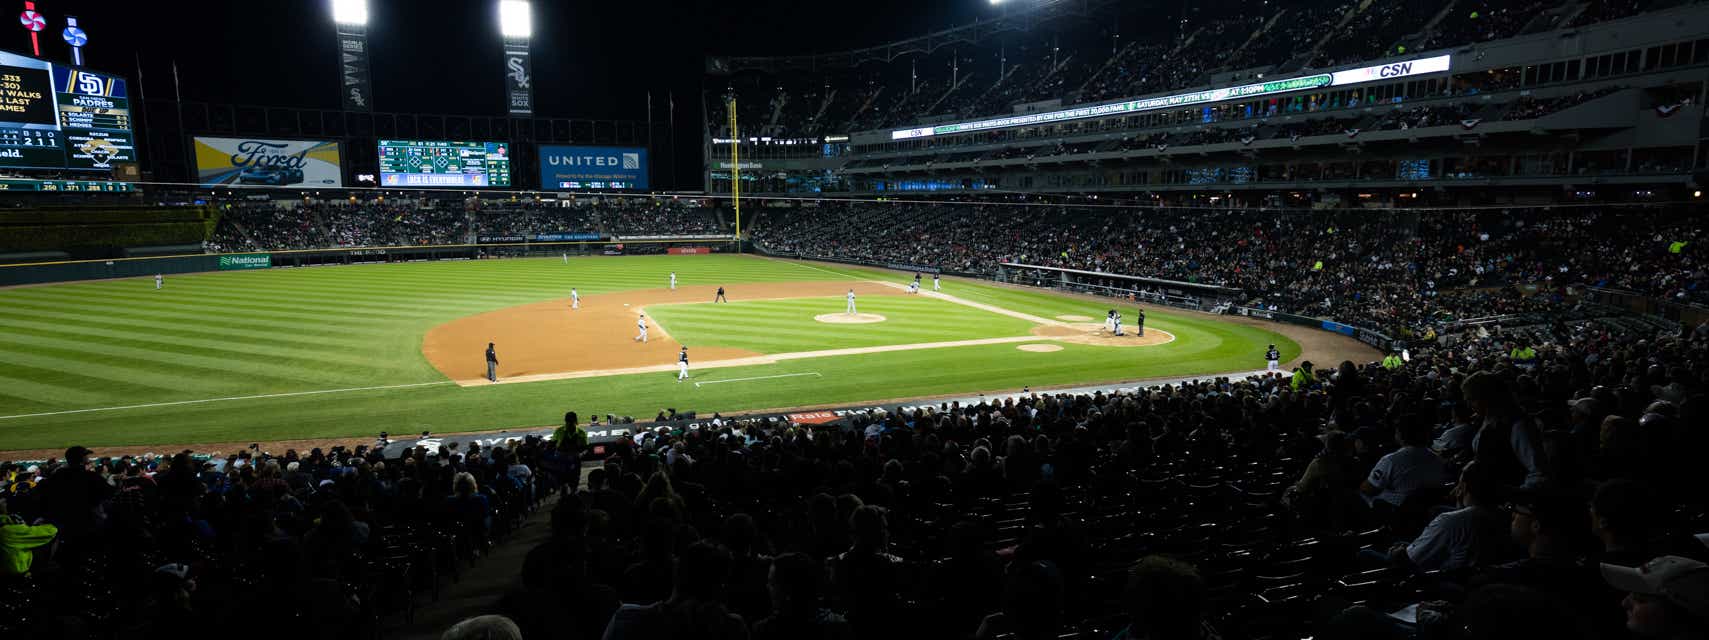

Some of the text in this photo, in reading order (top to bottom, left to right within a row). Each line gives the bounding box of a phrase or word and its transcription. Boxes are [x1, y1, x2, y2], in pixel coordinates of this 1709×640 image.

[1380, 62, 1413, 77] CSN
[6, 90, 41, 99] WALKS
[74, 98, 114, 108] PADRES
[1136, 98, 1168, 108] SATURDAY,
[38, 138, 44, 146] 1
[231, 141, 307, 169] Ford
[549, 156, 619, 166] UNITED
[232, 256, 270, 264] National
